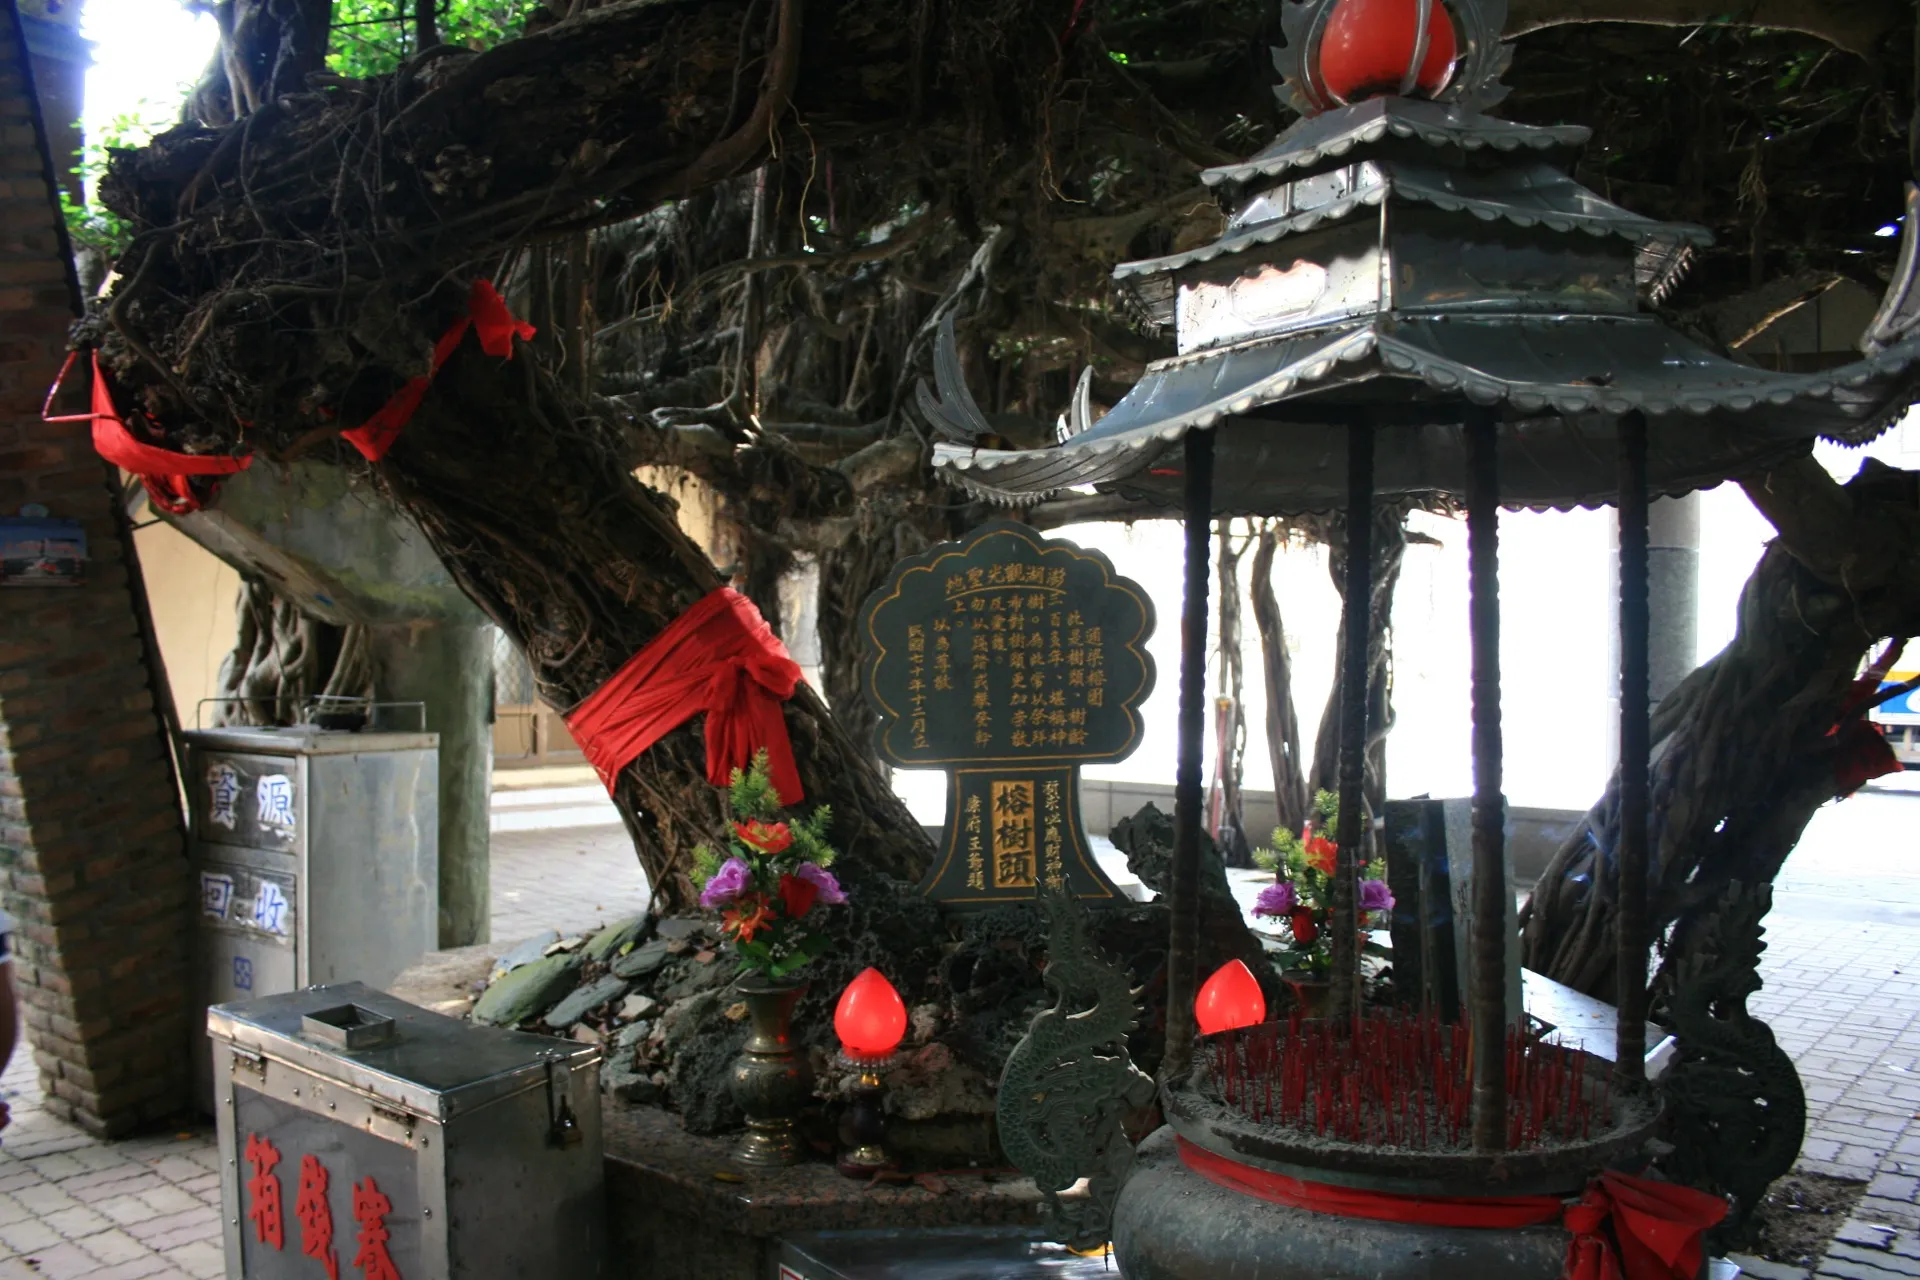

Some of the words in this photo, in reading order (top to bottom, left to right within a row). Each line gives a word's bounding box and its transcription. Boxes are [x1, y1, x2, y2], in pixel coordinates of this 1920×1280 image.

[946, 563, 1066, 594] 澎湖觀光聖地
[907, 624, 930, 749] 民國七十年十二月立
[211, 770, 293, 825] 資源
[995, 784, 1033, 884] 榕樹頭
[204, 877, 285, 936] 回收
